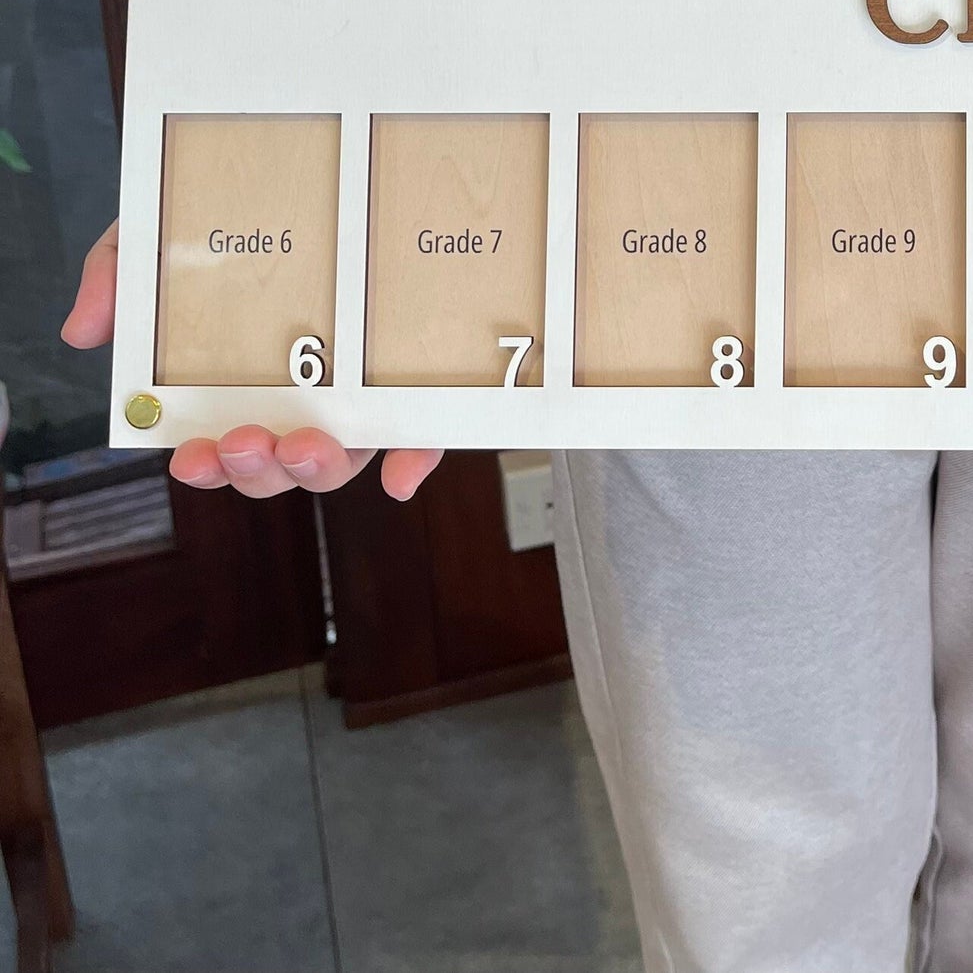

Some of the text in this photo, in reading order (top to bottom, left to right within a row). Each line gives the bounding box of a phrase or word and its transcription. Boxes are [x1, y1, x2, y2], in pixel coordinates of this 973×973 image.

[207, 228, 293, 255] Grade 6
[417, 228, 503, 255] Grade 7
[622, 228, 708, 255] Grade 8
[830, 228, 917, 255] Grade 9
[288, 335, 326, 387] 6
[498, 336, 534, 388] 7
[710, 335, 746, 388] 8
[922, 335, 958, 389] 9
